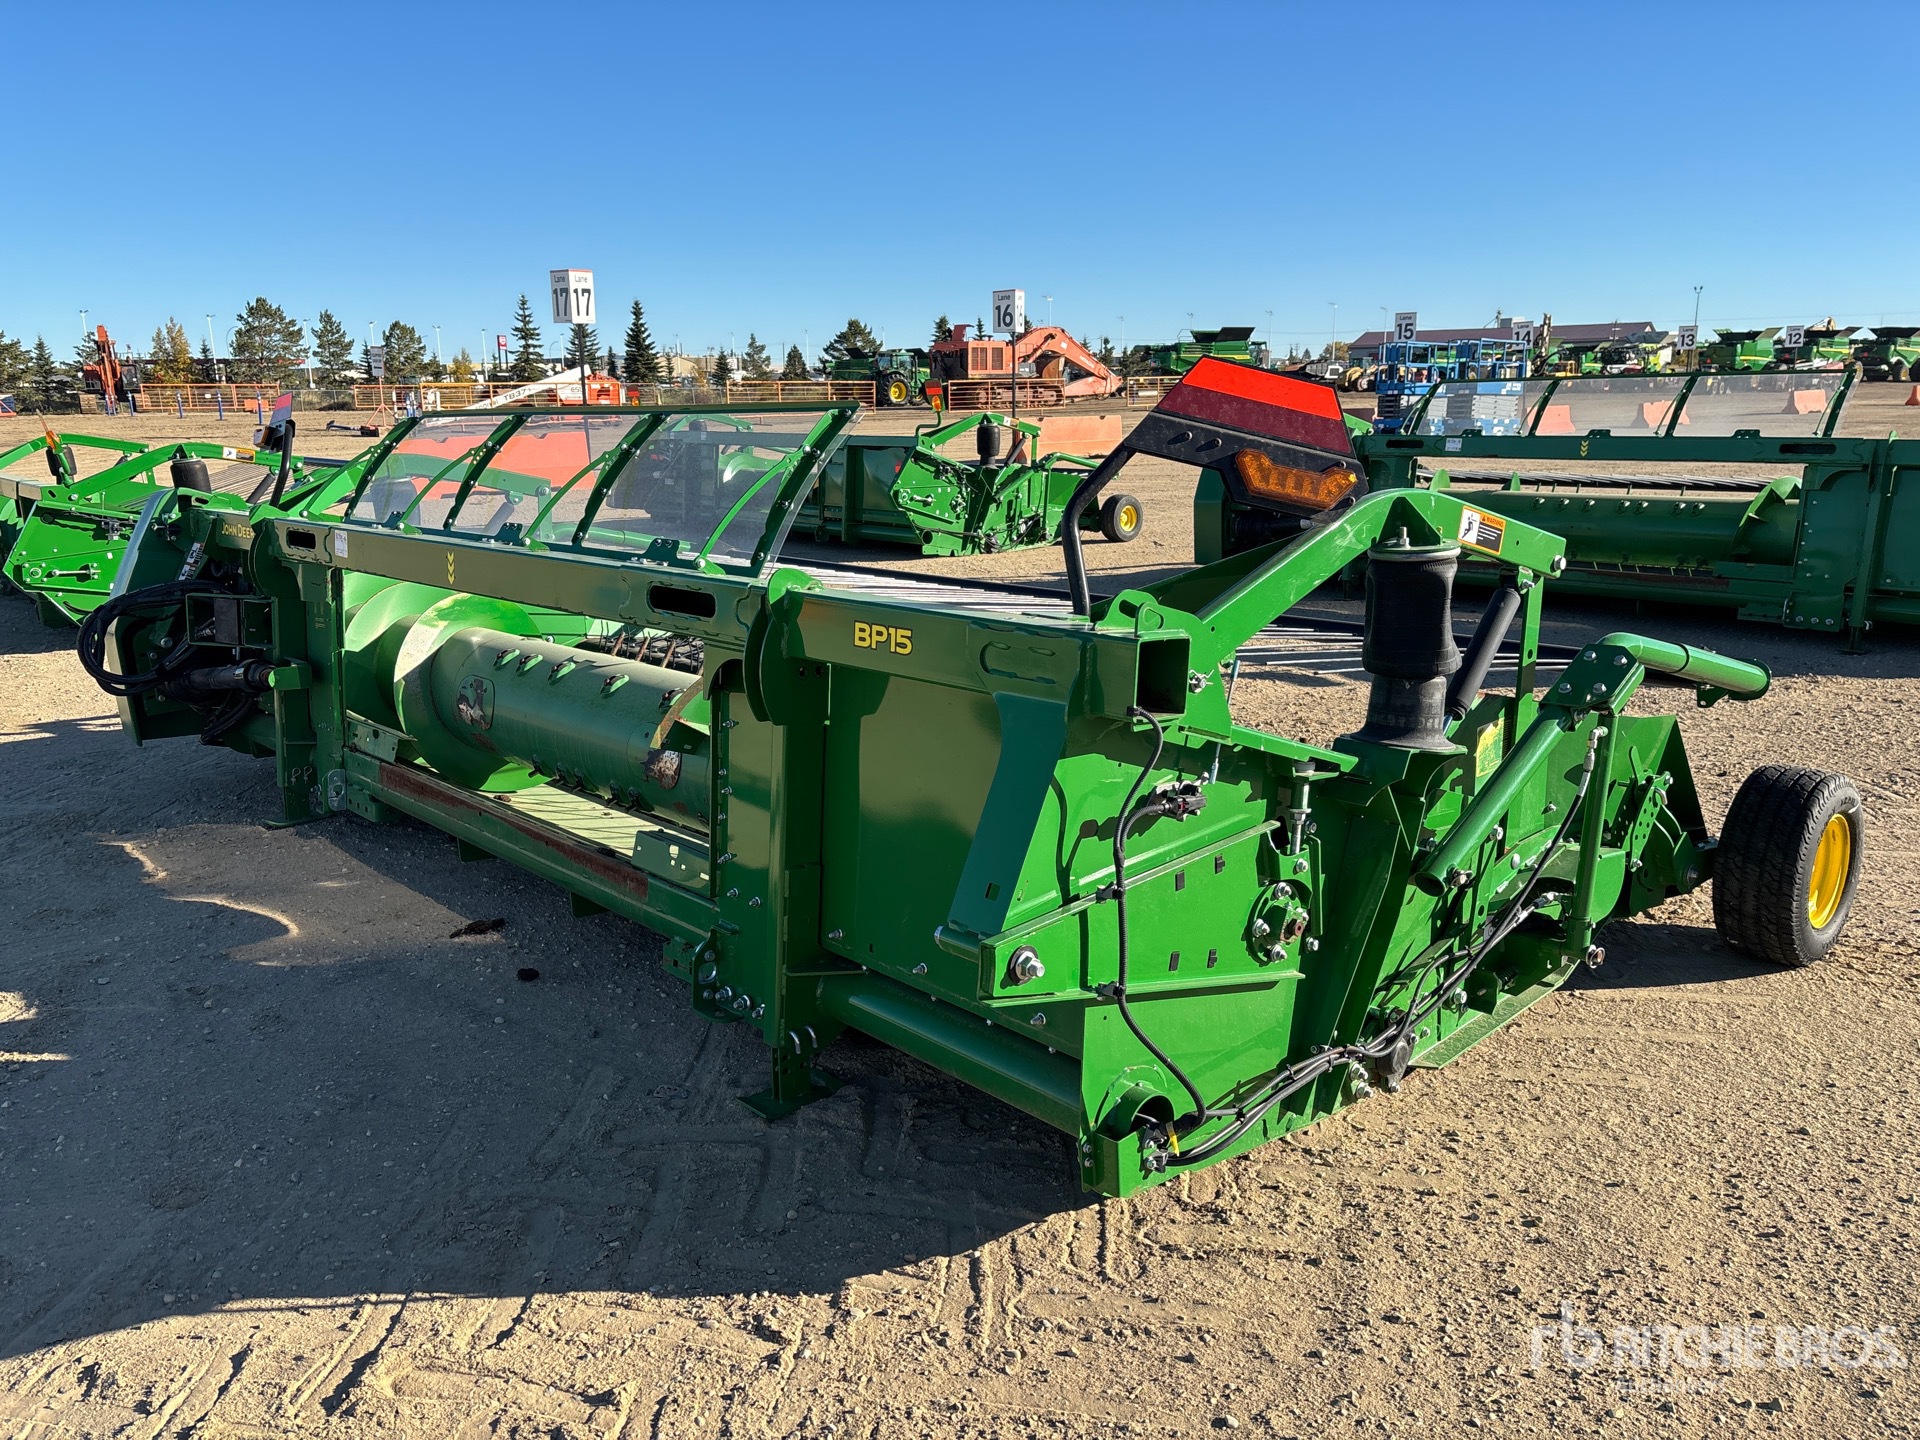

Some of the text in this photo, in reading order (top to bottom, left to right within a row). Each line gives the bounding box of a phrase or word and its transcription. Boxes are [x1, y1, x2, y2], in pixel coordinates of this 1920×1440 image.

[553, 274, 566, 283] Lane
[574, 274, 588, 283] Lane
[553, 287, 568, 317] 17
[573, 288, 591, 317] 17
[995, 304, 1014, 328] 16
[1396, 323, 1414, 340] 15
[1514, 330, 1532, 347] 14
[1680, 333, 1695, 347] 13
[1788, 332, 1802, 345] 12
[221, 522, 256, 538] JOHN DEER
[853, 620, 914, 656] BP15
